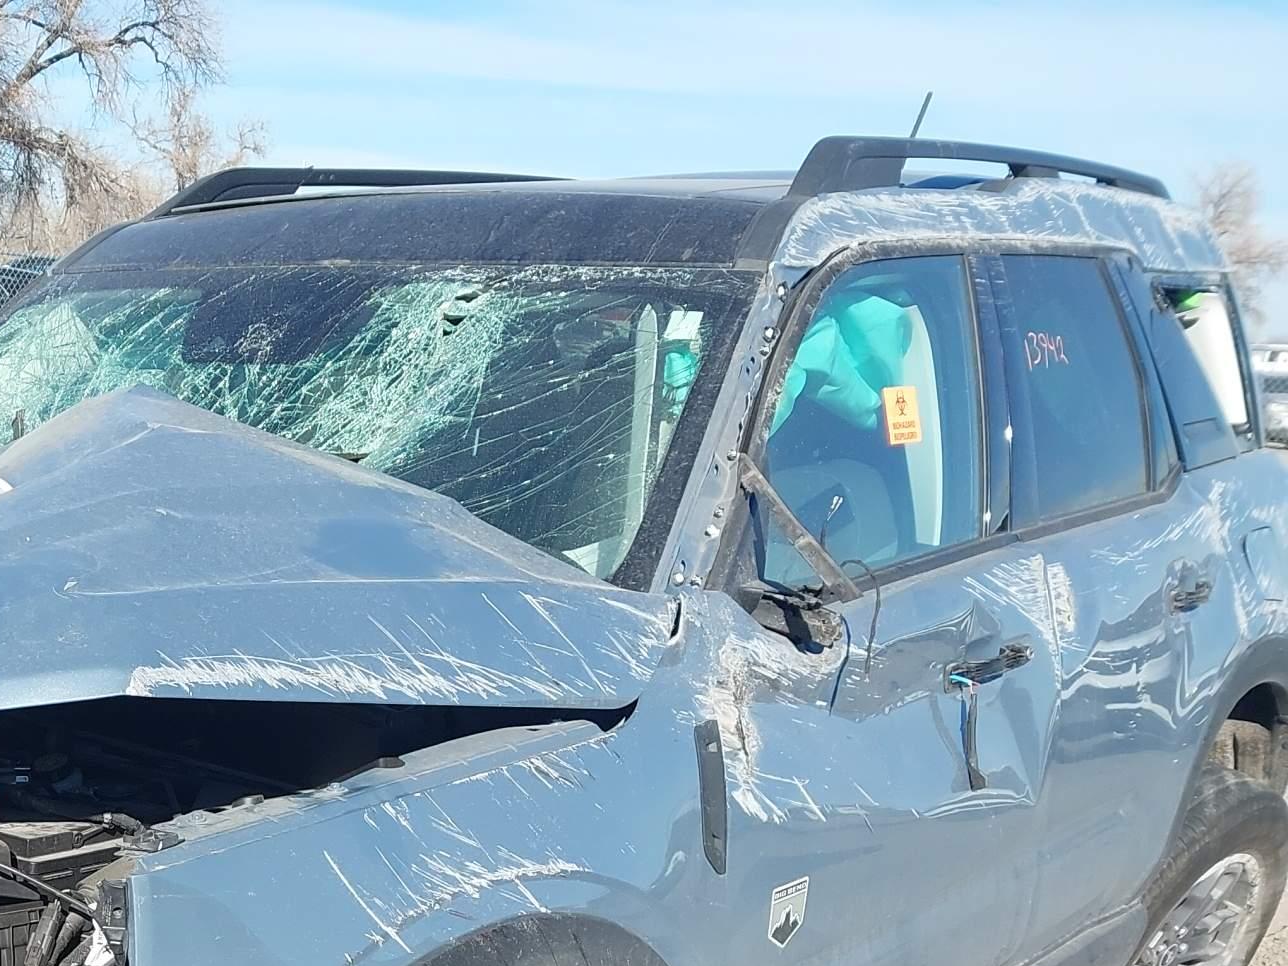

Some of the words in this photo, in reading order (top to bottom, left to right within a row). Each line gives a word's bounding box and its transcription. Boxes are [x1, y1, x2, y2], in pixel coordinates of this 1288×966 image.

[1024, 331, 1069, 371] 13942
[774, 890, 787, 900] BIG
[787, 883, 807, 895] BEND
